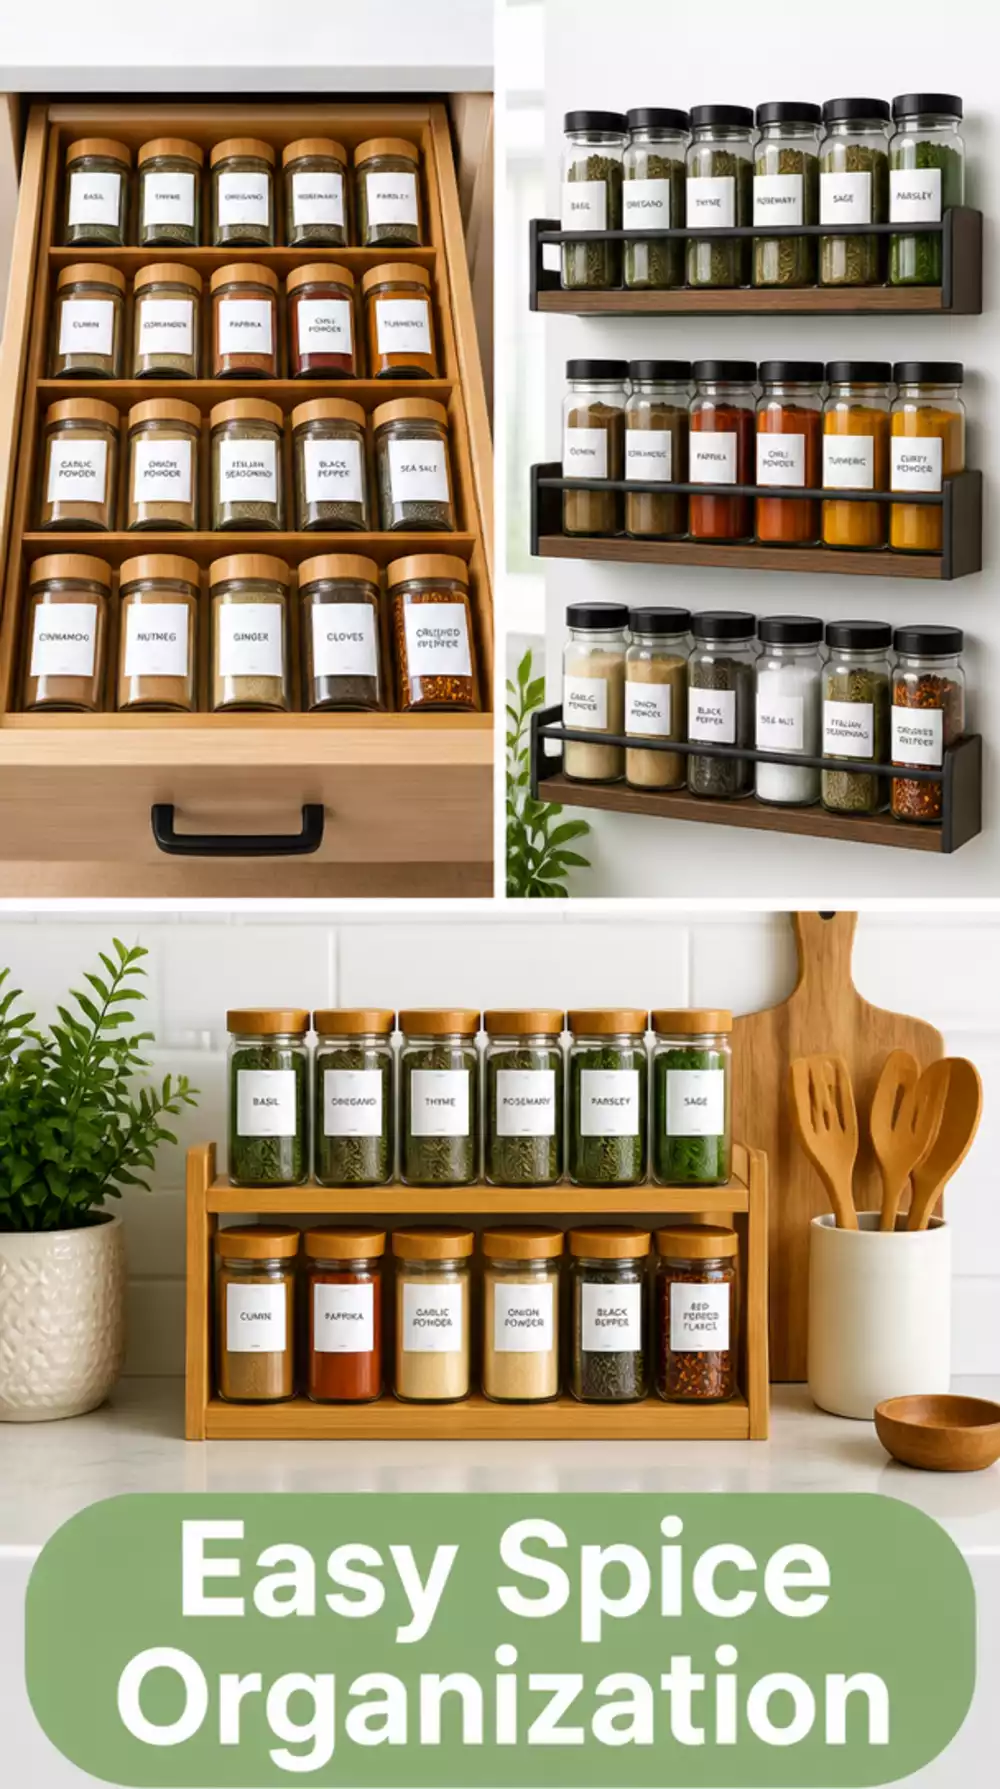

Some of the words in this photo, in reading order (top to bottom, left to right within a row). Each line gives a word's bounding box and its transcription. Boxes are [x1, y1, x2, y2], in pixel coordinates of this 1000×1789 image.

[252, 1097, 281, 1107] BASIL
[331, 1097, 377, 1107] OREGANO
[424, 1097, 456, 1107] THYME
[502, 1097, 551, 1107] ROSEMARY
[590, 1097, 631, 1107] PARSLEY
[683, 1097, 708, 1107] SAGE
